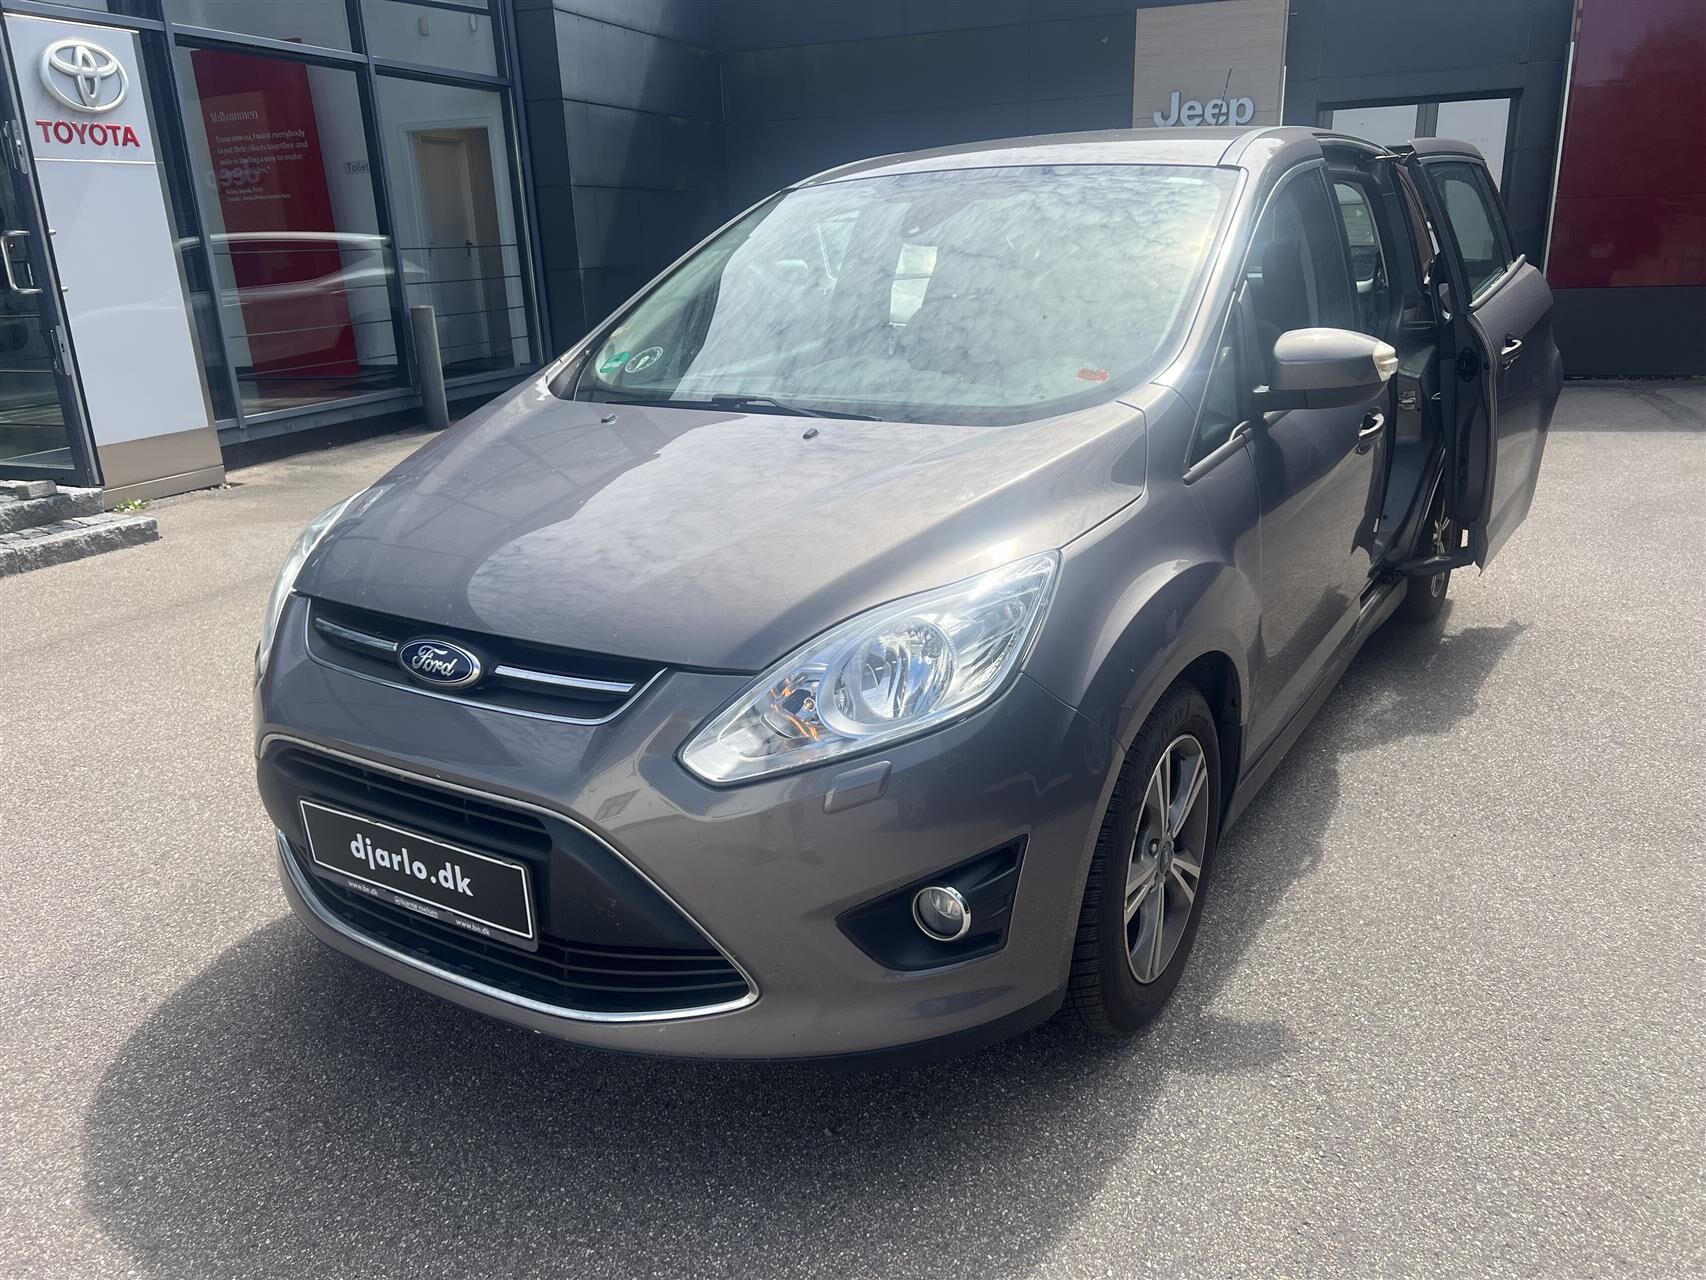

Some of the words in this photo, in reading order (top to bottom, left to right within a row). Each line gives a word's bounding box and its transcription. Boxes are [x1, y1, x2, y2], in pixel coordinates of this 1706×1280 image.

[210, 110, 259, 122] Velkommen
[1153, 91, 1255, 127] Jeep
[35, 119, 141, 148] TOYOTA
[256, 132, 271, 140] want
[271, 128, 305, 140] everybody
[267, 141, 294, 152] together
[295, 139, 308, 148] and
[345, 162, 370, 173] Toilet
[411, 645, 458, 677] Ford
[350, 833, 474, 897] djarlo.dk
[348, 880, 379, 898] www.bn.dk
[455, 918, 491, 937] www.bn.dk
